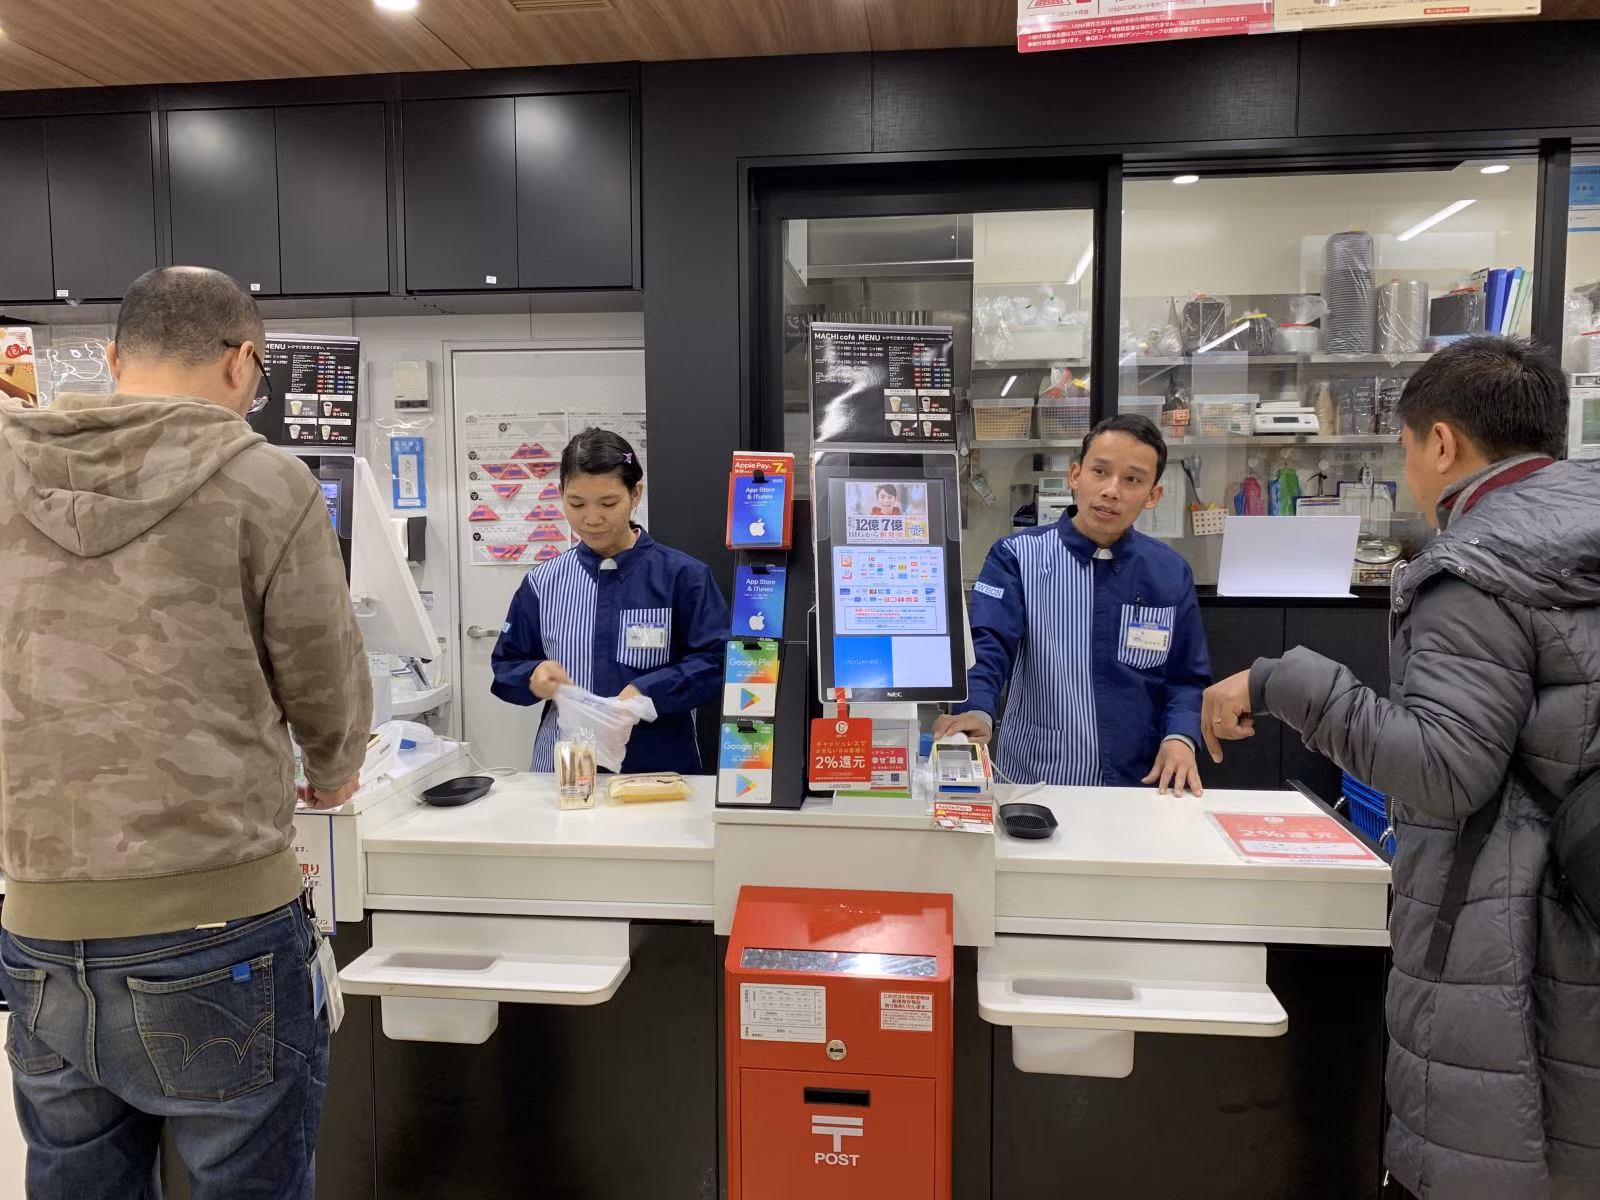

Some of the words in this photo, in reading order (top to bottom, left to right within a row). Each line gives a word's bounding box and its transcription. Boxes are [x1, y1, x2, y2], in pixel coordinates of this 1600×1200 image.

[729, 657, 758, 668] Google
[723, 741, 753, 752] Google
[753, 741, 769, 752] Play
[815, 755, 866, 769] 2%還元
[814, 1152, 860, 1166] POST
